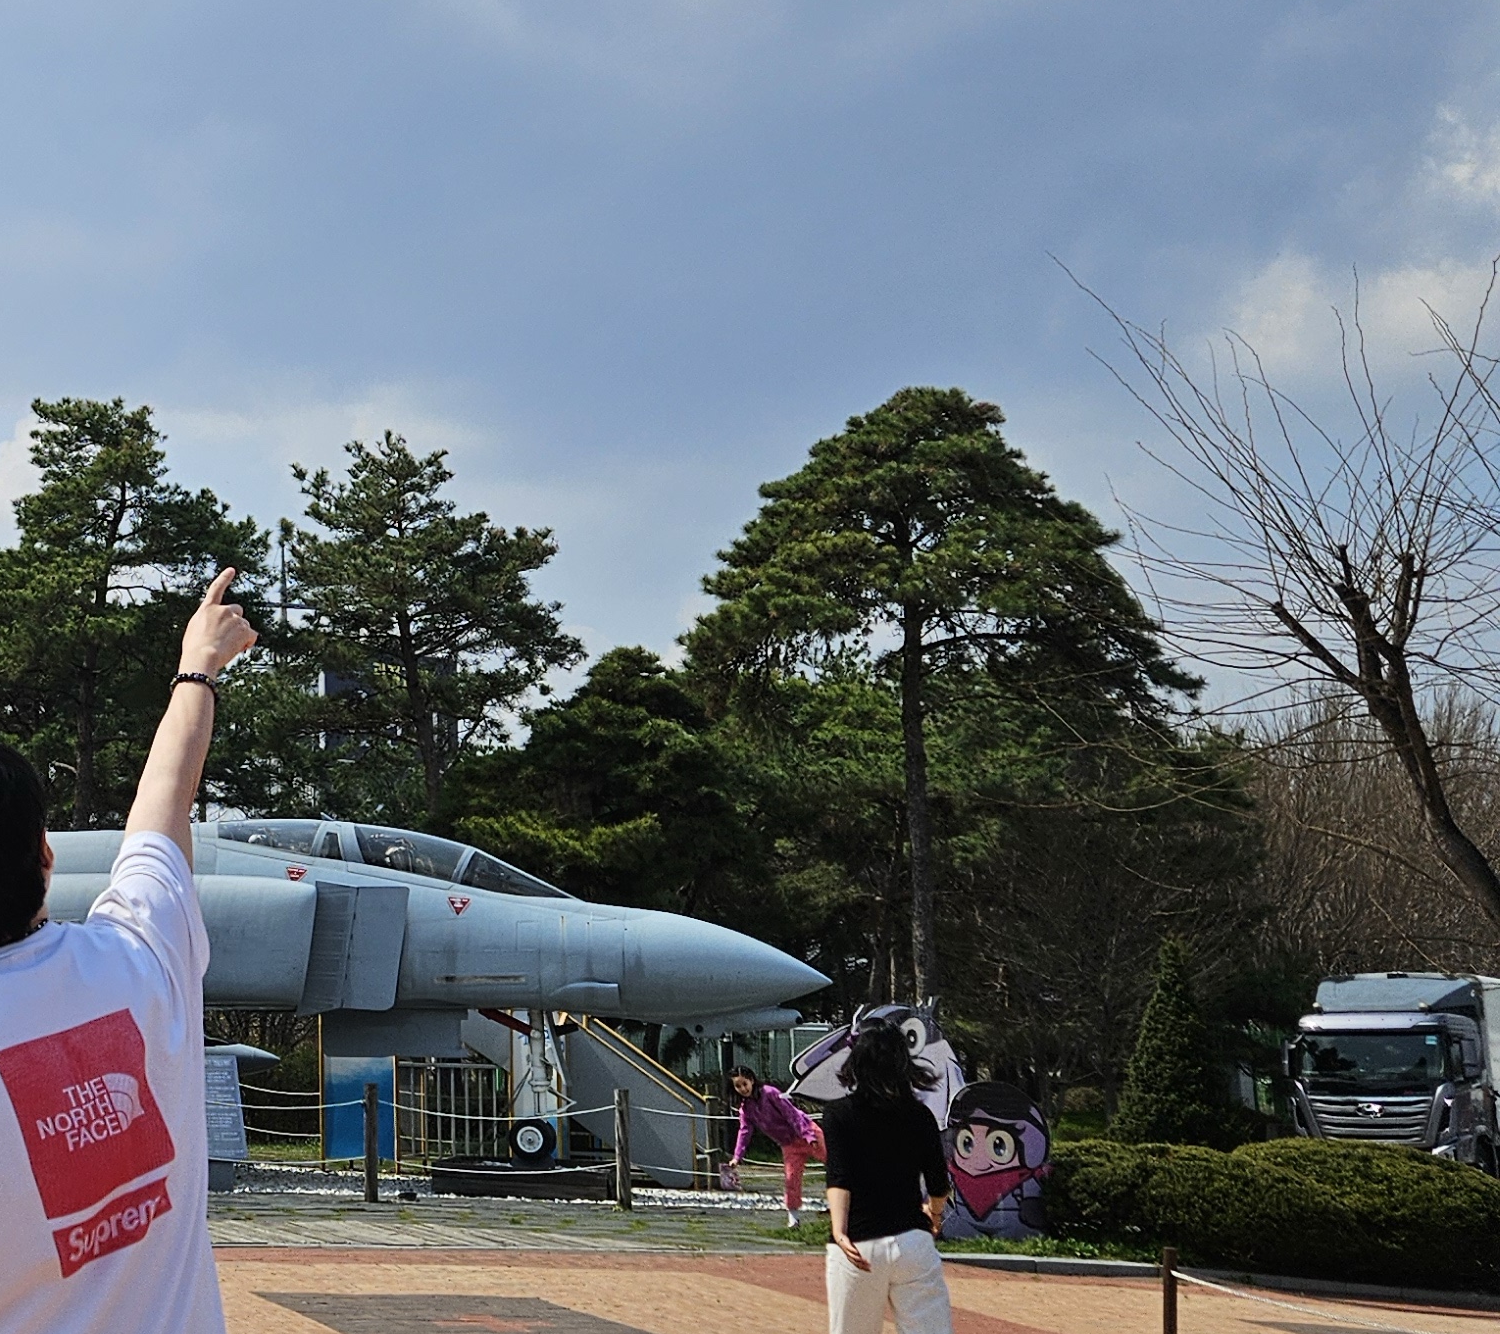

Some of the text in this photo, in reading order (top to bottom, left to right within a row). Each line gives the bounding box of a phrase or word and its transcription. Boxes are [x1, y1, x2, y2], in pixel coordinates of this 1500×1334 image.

[62, 1076, 106, 1107] THE
[36, 1095, 114, 1141] NORTH
[66, 1112, 122, 1152] FACE
